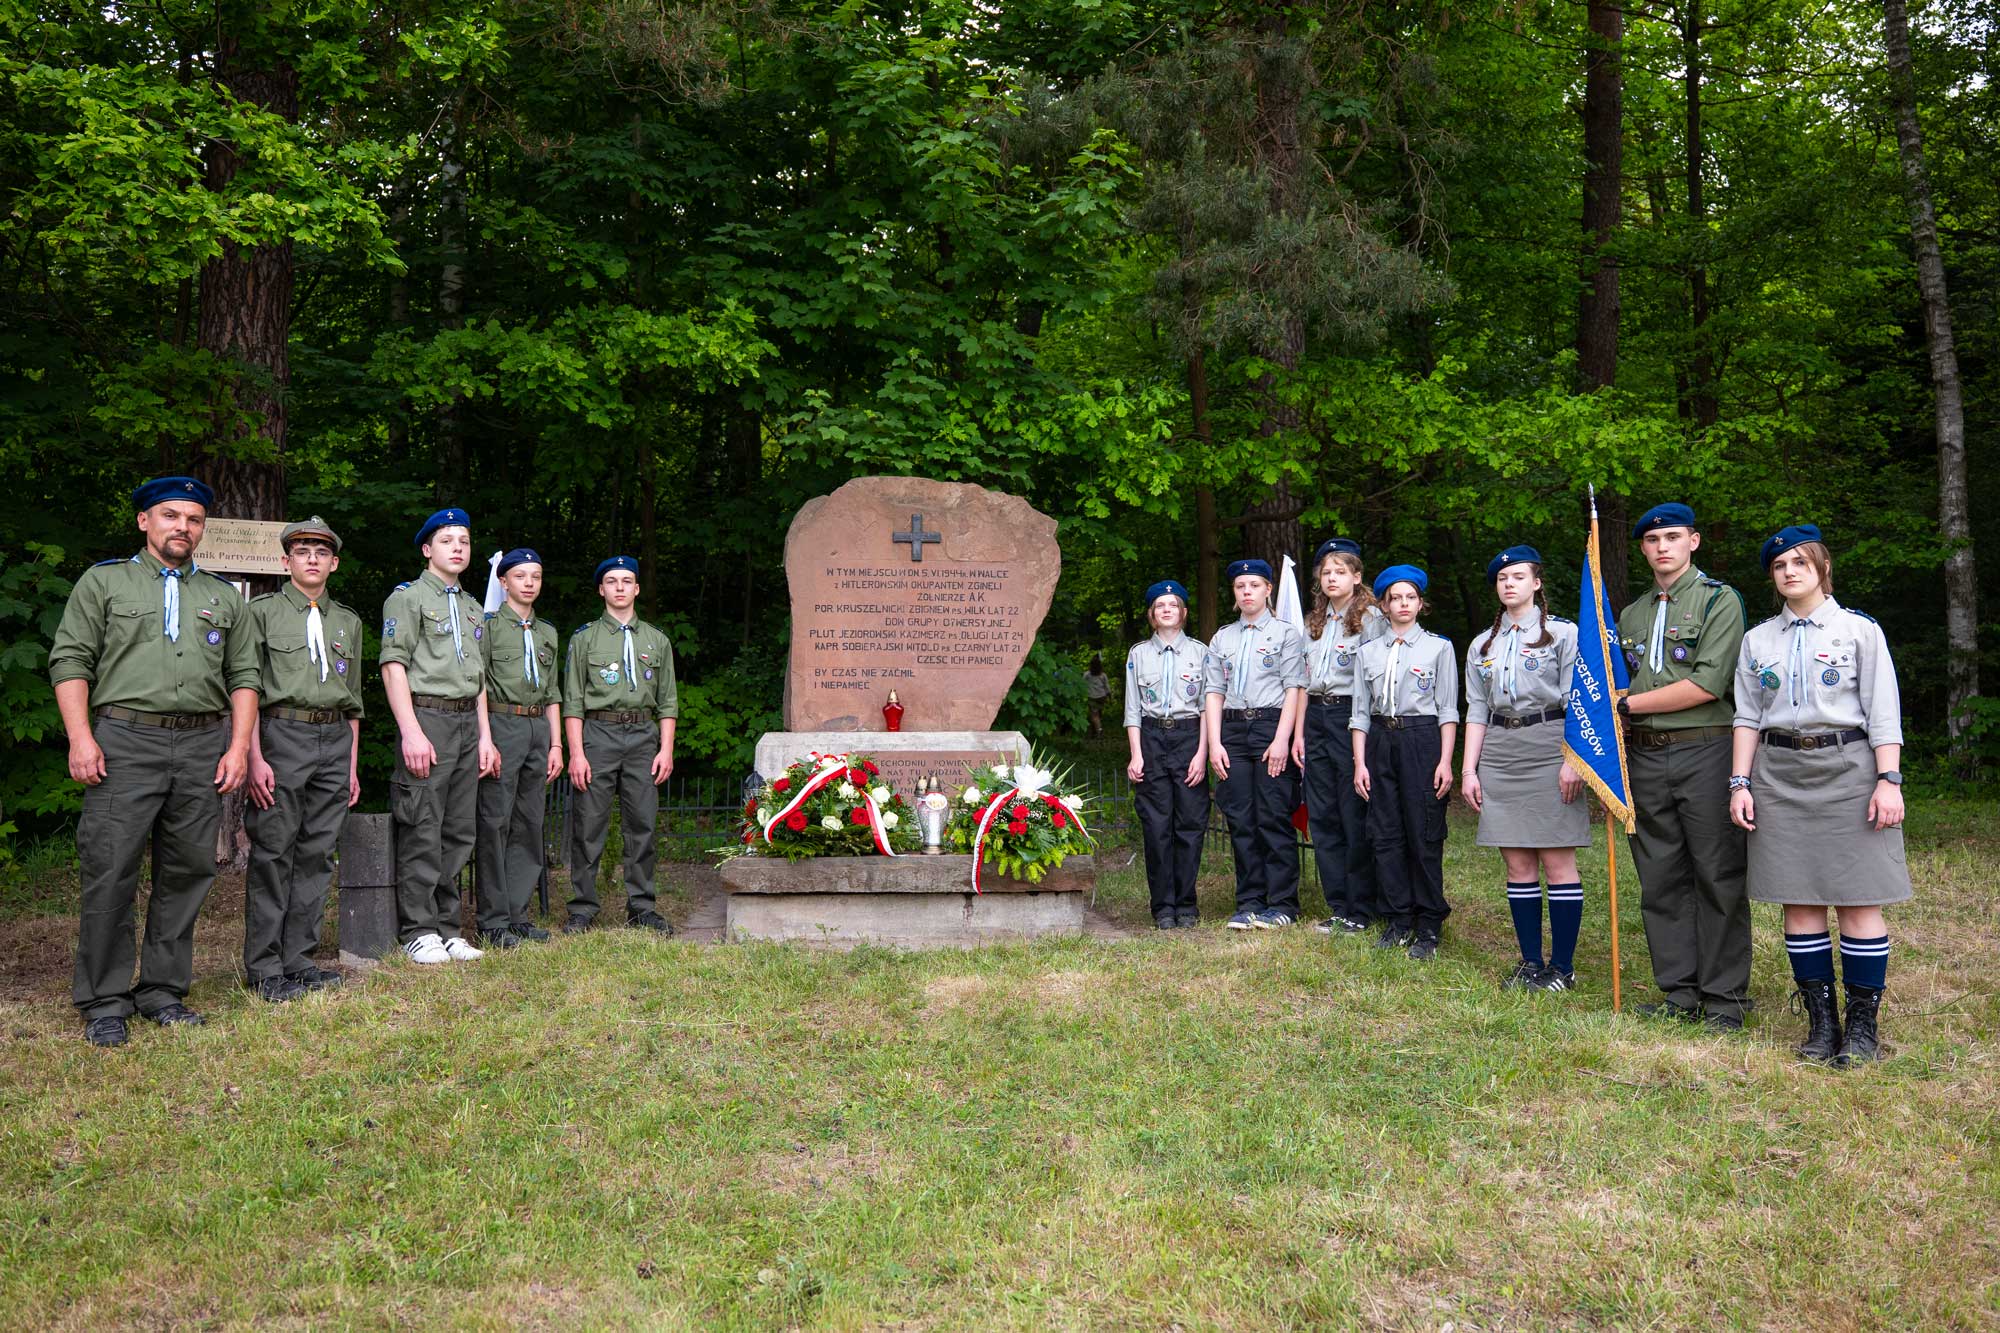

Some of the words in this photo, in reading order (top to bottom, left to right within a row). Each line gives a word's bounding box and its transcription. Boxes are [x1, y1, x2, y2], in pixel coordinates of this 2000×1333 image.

[218, 551, 279, 563] Partyzantów
[826, 568, 834, 576] W
[836, 568, 856, 576] TYM
[858, 568, 897, 577] MIEJSCU
[969, 569, 976, 578] W
[978, 570, 1009, 579] WALCE
[841, 581, 908, 589] HITLEROWSKIM
[911, 581, 964, 590] OKUPANTEM
[836, 604, 905, 614] KRUSZELNICKI
[908, 604, 950, 614] ZBIGNIEW
[987, 606, 1005, 616] LAT
[1008, 606, 1019, 616] 22
[907, 618, 938, 627] GRUPY
[838, 629, 897, 639] JEZIOROWSKI
[991, 632, 1009, 640] LAT
[1011, 631, 1024, 641] 24
[841, 642, 904, 651] SOBIERAJSKI
[906, 642, 940, 652] WITOLD
[993, 644, 1010, 653] LAT
[1012, 645, 1020, 653] 21
[950, 656, 965, 665] ICH
[814, 668, 828, 677] BY
[831, 668, 857, 677] CZAS
[861, 668, 877, 677] NIE
[1568, 688, 1606, 757] Szeregów
[880, 759, 926, 767] ECHODNIU
